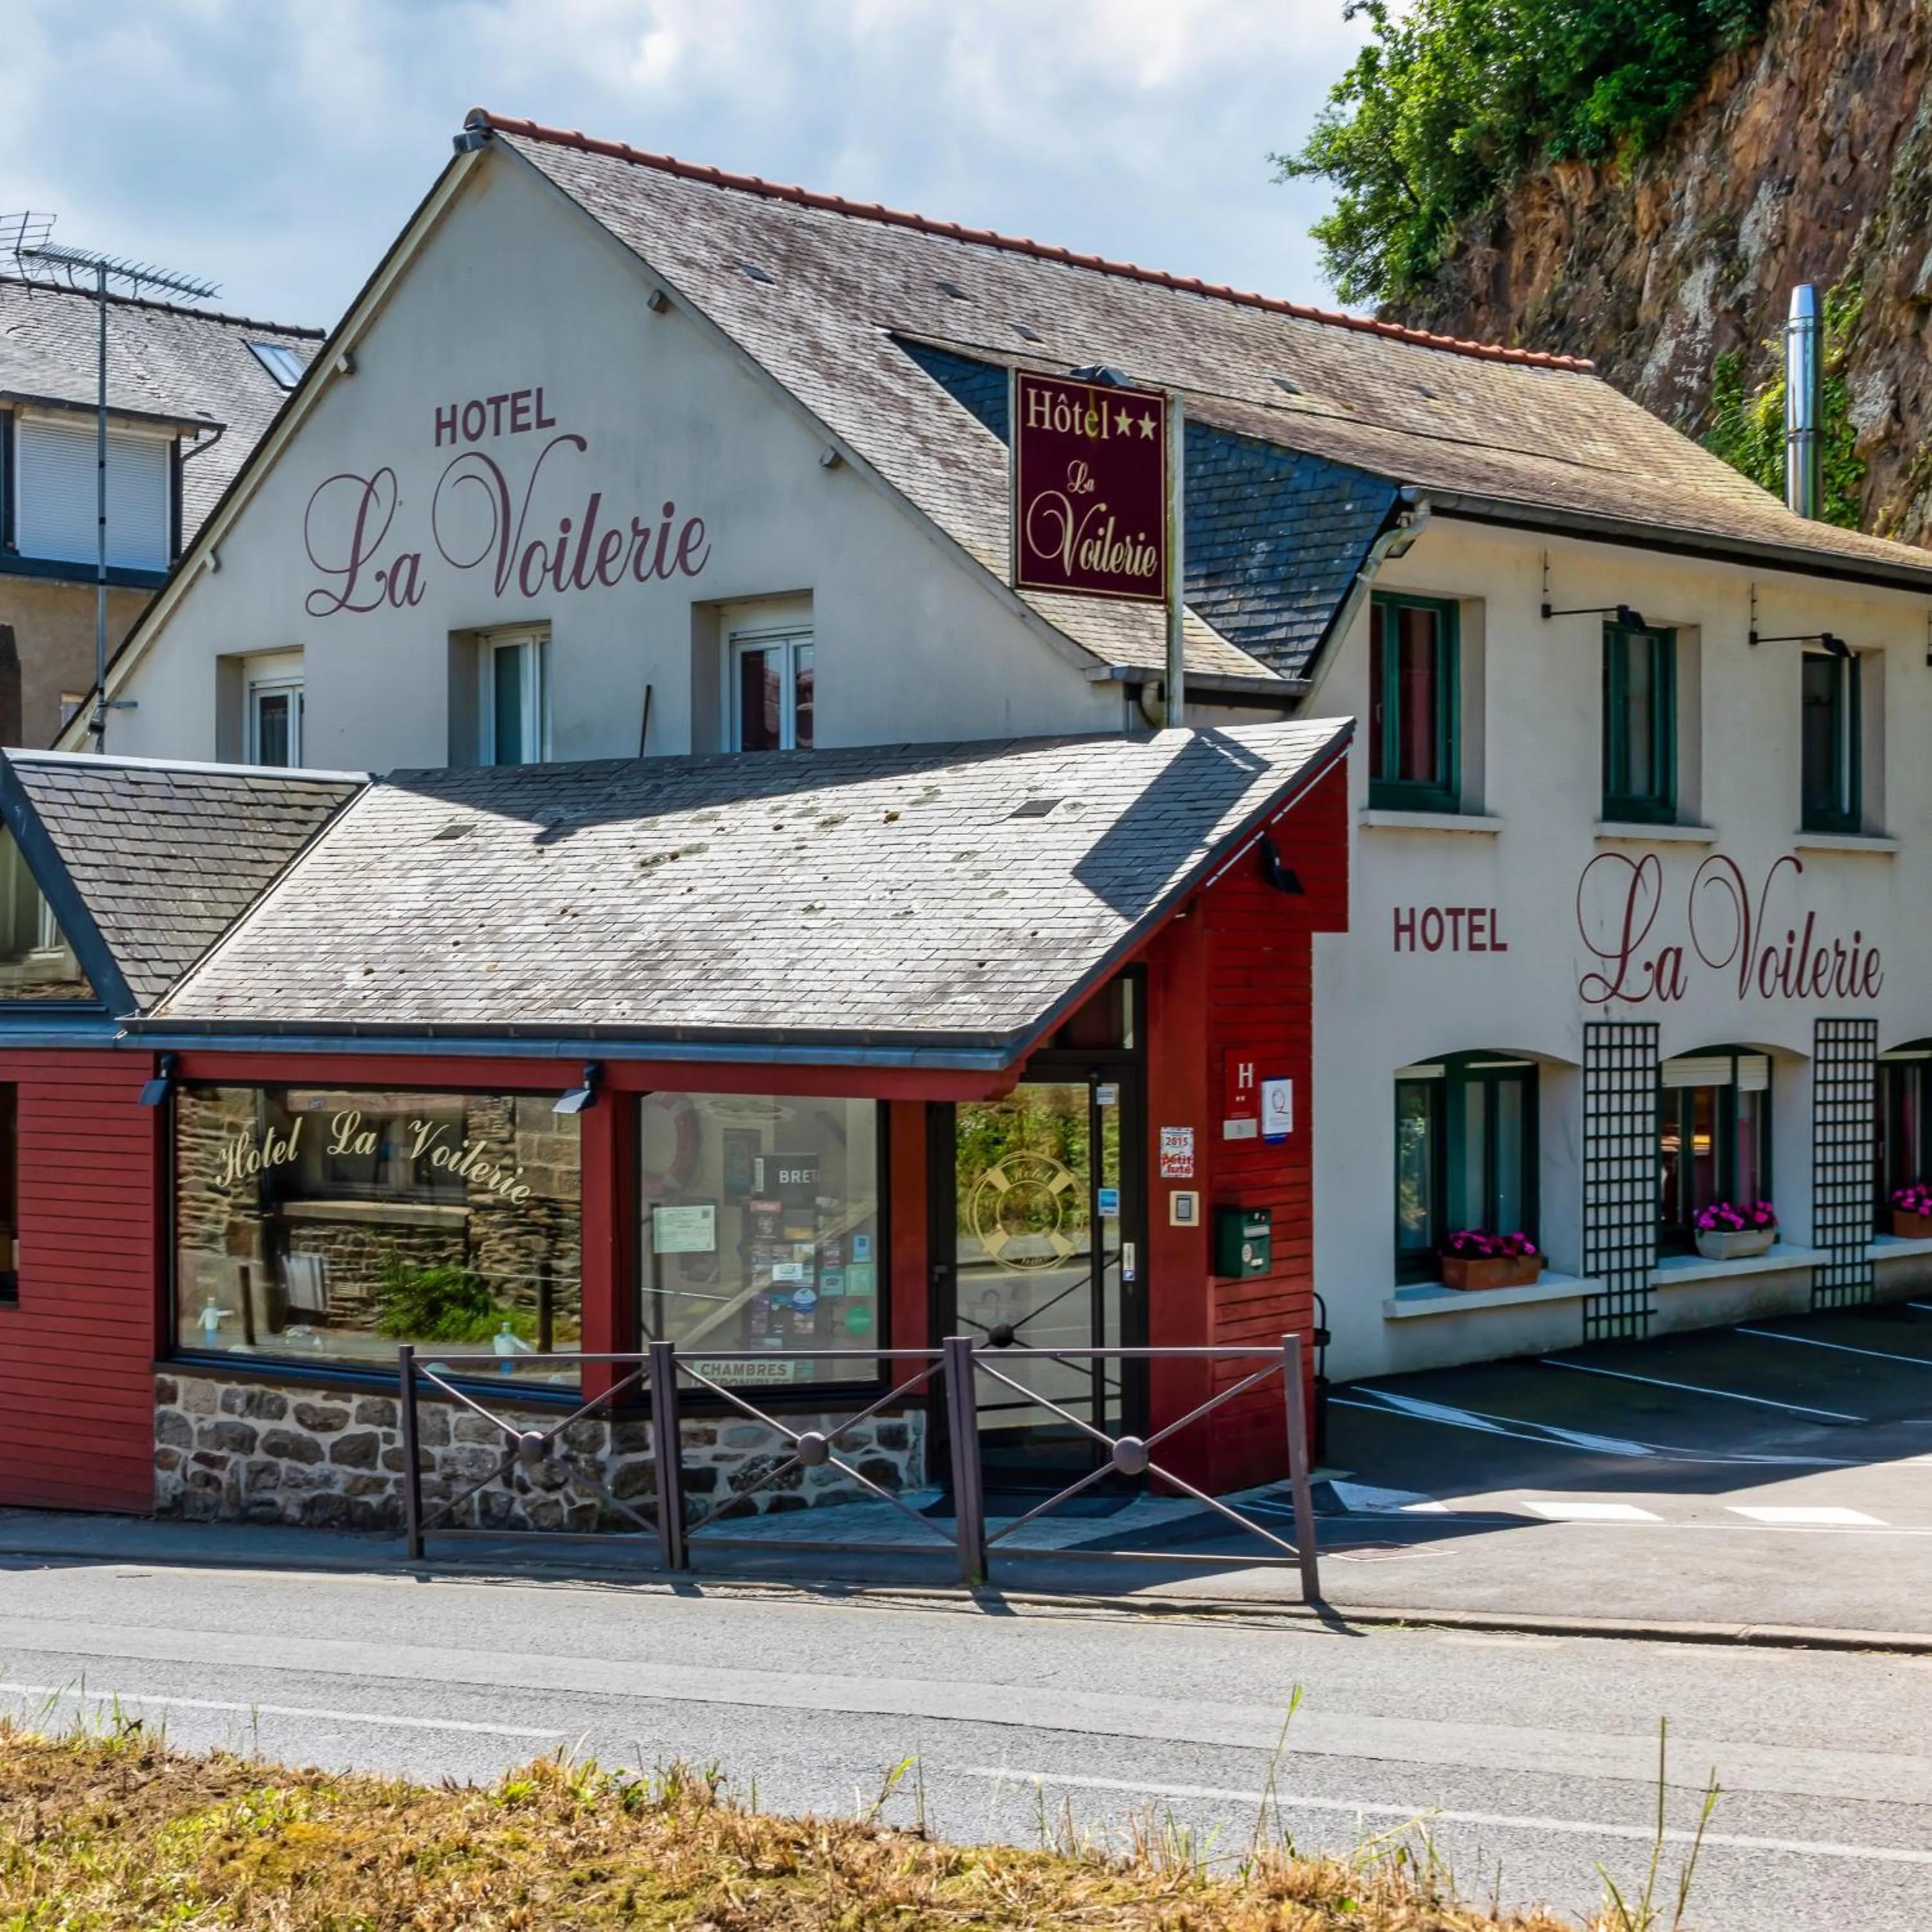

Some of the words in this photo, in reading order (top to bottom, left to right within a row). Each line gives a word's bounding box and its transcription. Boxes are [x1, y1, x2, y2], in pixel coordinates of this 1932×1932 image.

[435, 387, 556, 447] HOTEL
[1026, 388, 1110, 440] Hôtel
[1066, 460, 1095, 494] La
[305, 466, 426, 616] La
[433, 433, 711, 598] Voilerie
[1027, 490, 1158, 577] Voilerie
[1392, 907, 1508, 952] HOTEL
[1577, 852, 1687, 1004] La
[1689, 855, 1884, 1000] Voilerie
[1238, 1063, 1254, 1088] H
[216, 1116, 303, 1188] Hotel
[327, 1110, 379, 1156] La
[408, 1119, 533, 1206] Voilerie
[1166, 1137, 1188, 1146] 2015
[701, 1363, 787, 1376] CHAMBRES
